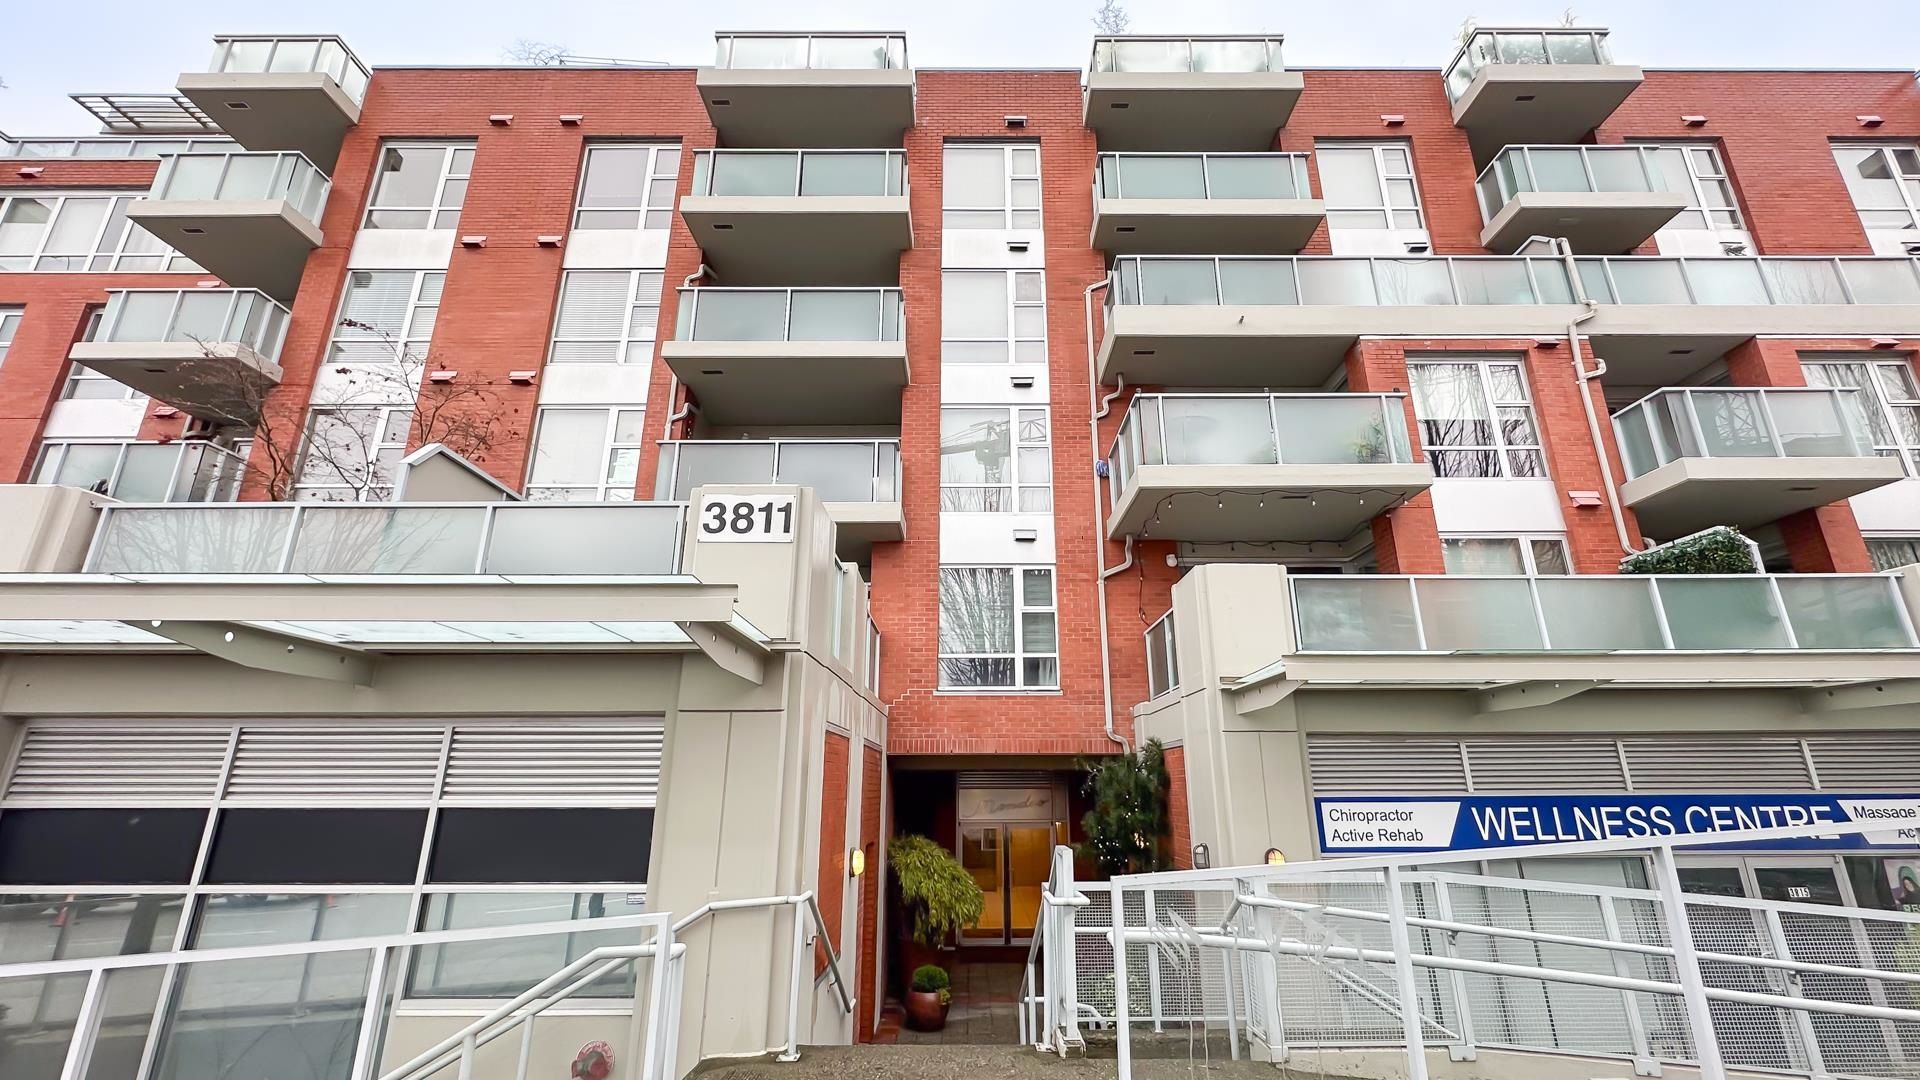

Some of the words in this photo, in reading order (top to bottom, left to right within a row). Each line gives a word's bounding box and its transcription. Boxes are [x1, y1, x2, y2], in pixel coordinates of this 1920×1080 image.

[703, 502, 792, 534] 3811
[1329, 808, 1414, 824] Chiropractor
[1852, 805, 1917, 819] Massage
[1471, 805, 1676, 841] WELLNESS
[1684, 805, 1841, 839] CENTRE
[1332, 828, 1374, 842] Active
[1378, 828, 1424, 842] Rehab
